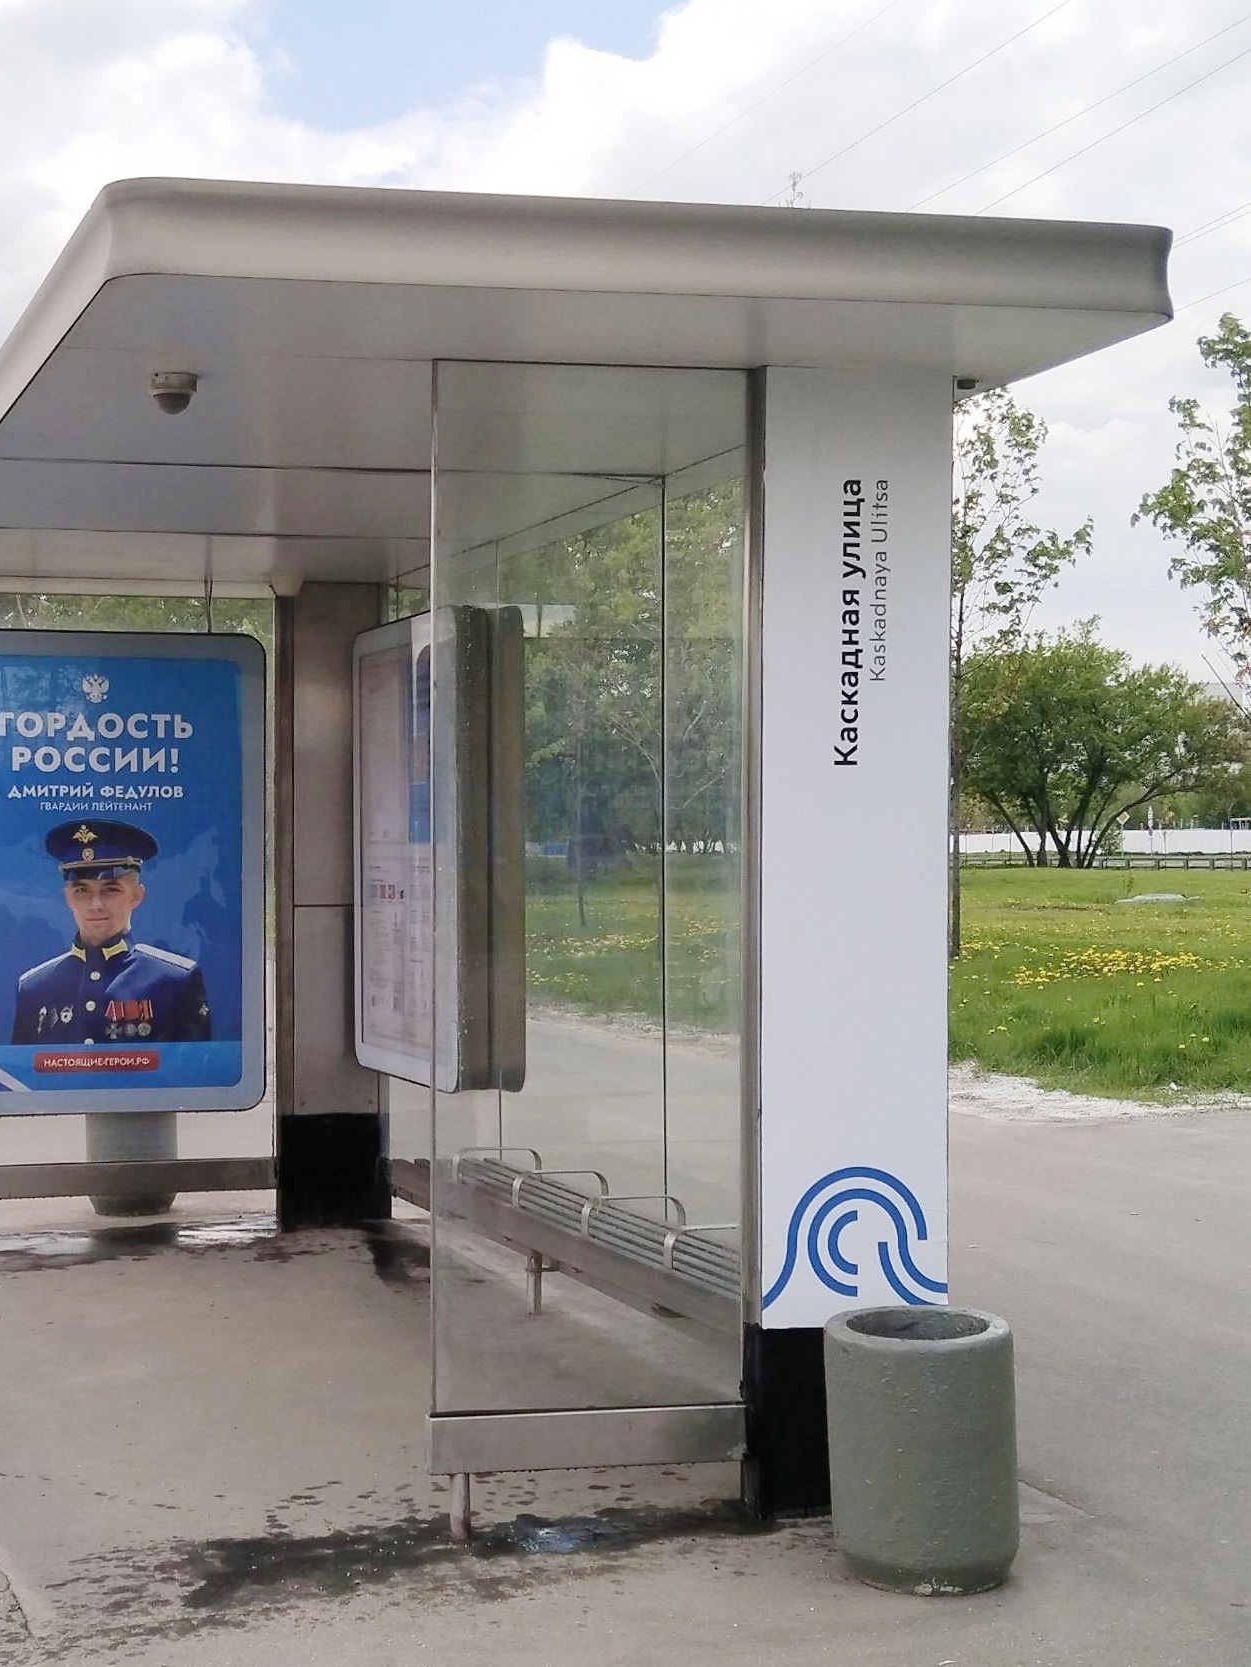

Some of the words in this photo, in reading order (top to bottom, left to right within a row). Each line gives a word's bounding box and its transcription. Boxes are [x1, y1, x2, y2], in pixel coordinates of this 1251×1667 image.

[841, 479, 866, 580] улица
[869, 479, 890, 544] Ulitsa
[869, 551, 892, 682] Kaskadnaya
[834, 590, 862, 767] Каскадная
[11, 746, 180, 773] РОССИИ!
[7, 782, 94, 799] ДМИТРИЙ
[99, 785, 184, 799] ФЕДУЛОВ
[39, 801, 90, 812] ГВАРДИИ
[91, 801, 153, 812] ЛЕЙТЕНАНТ
[43, 1057, 151, 1067] НАСТОЯЩИЕ-ГЕРОИ.РФ
